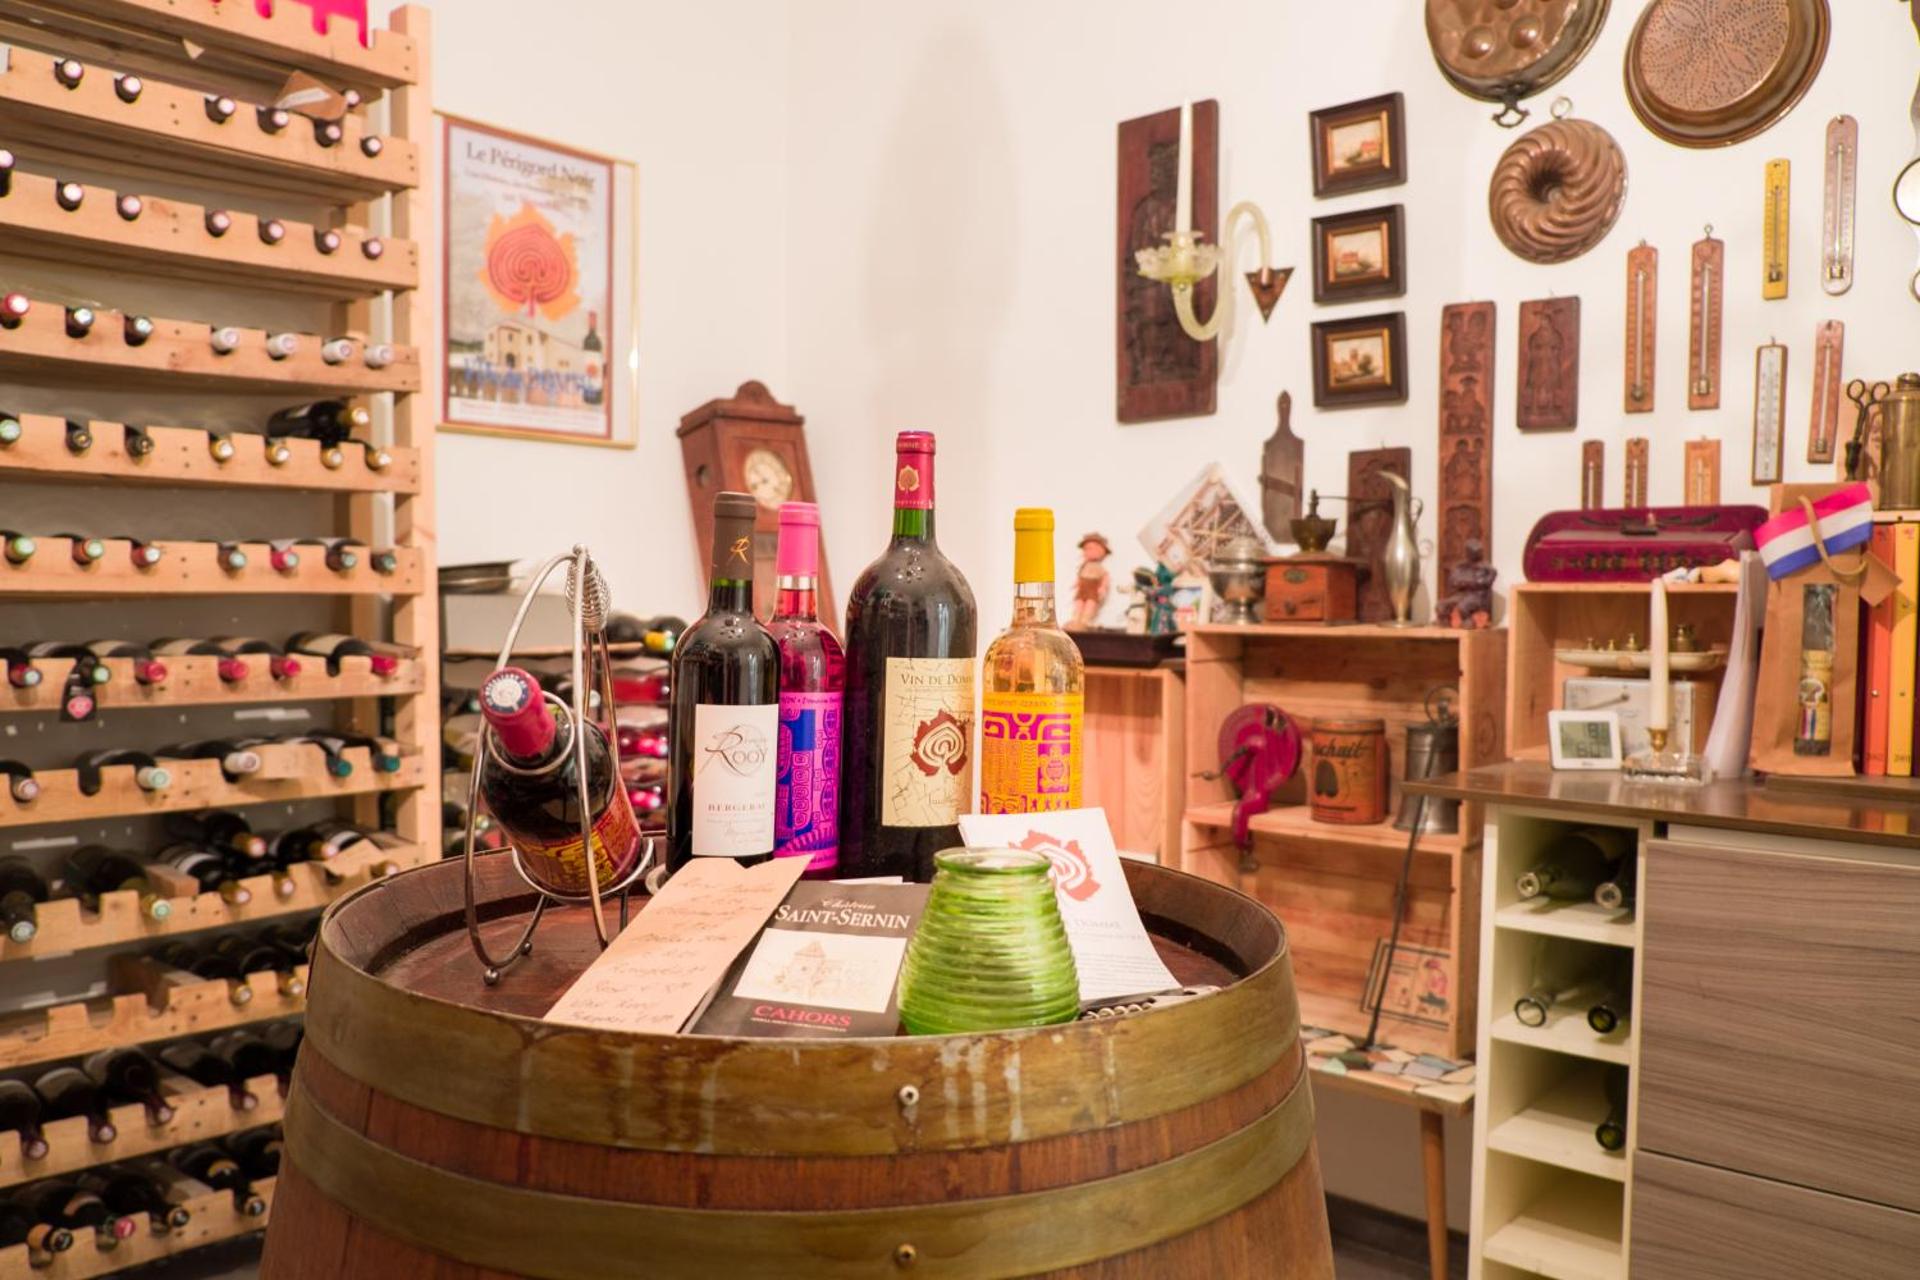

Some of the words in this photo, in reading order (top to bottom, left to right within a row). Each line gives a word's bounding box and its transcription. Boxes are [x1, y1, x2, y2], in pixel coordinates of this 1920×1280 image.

[466, 141, 488, 161] Le
[900, 673, 925, 685] VIN
[820, 900, 877, 911] Château
[775, 904, 911, 929] SAINT-SERNIN
[753, 1004, 851, 1028] CAHORS
